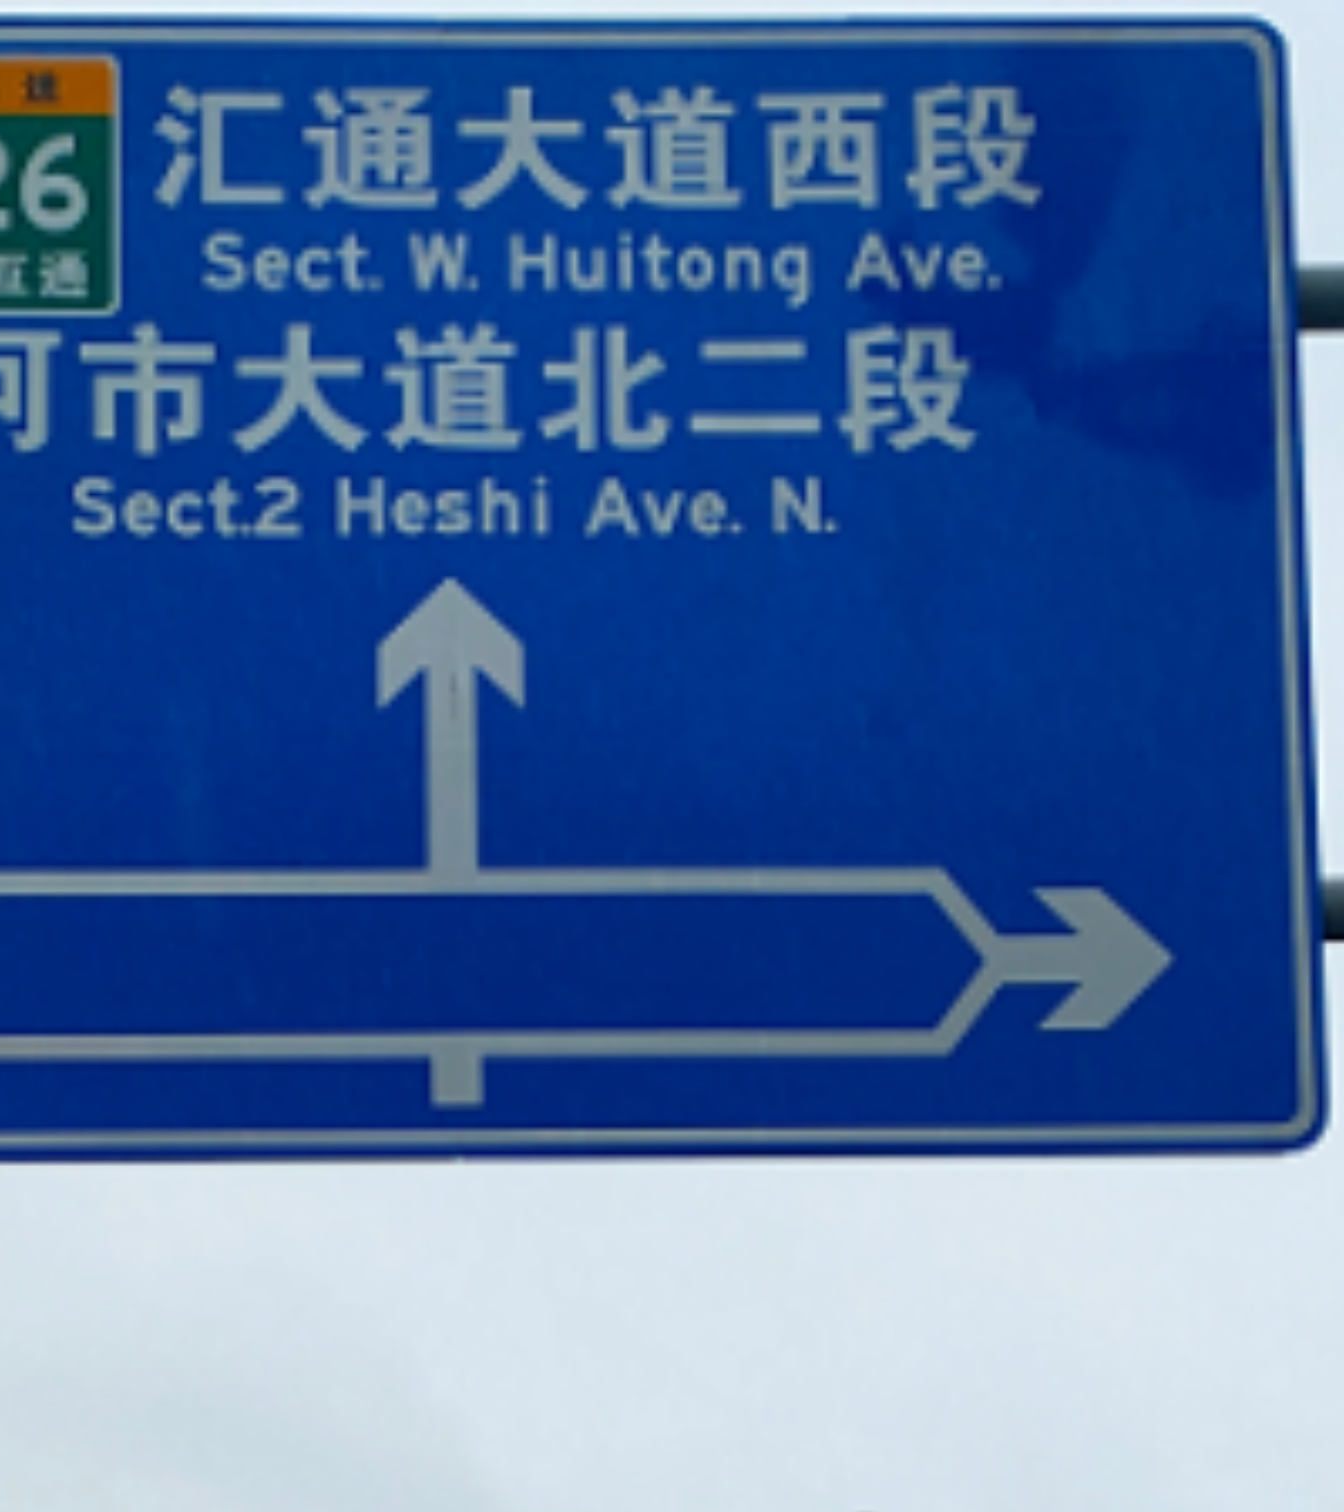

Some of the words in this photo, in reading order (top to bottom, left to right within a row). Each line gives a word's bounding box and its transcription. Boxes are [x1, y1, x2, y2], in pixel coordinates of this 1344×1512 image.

[154, 83, 1042, 211] 汇通大道西段
[202, 231, 382, 291] Sect.
[408, 232, 479, 291] W.
[509, 233, 811, 309] Huitong
[846, 232, 1002, 290] Ave.
[72, 476, 302, 537] Sect.2
[336, 475, 549, 536] Heshi
[585, 476, 743, 536] Ave.
[771, 476, 838, 534] N.
